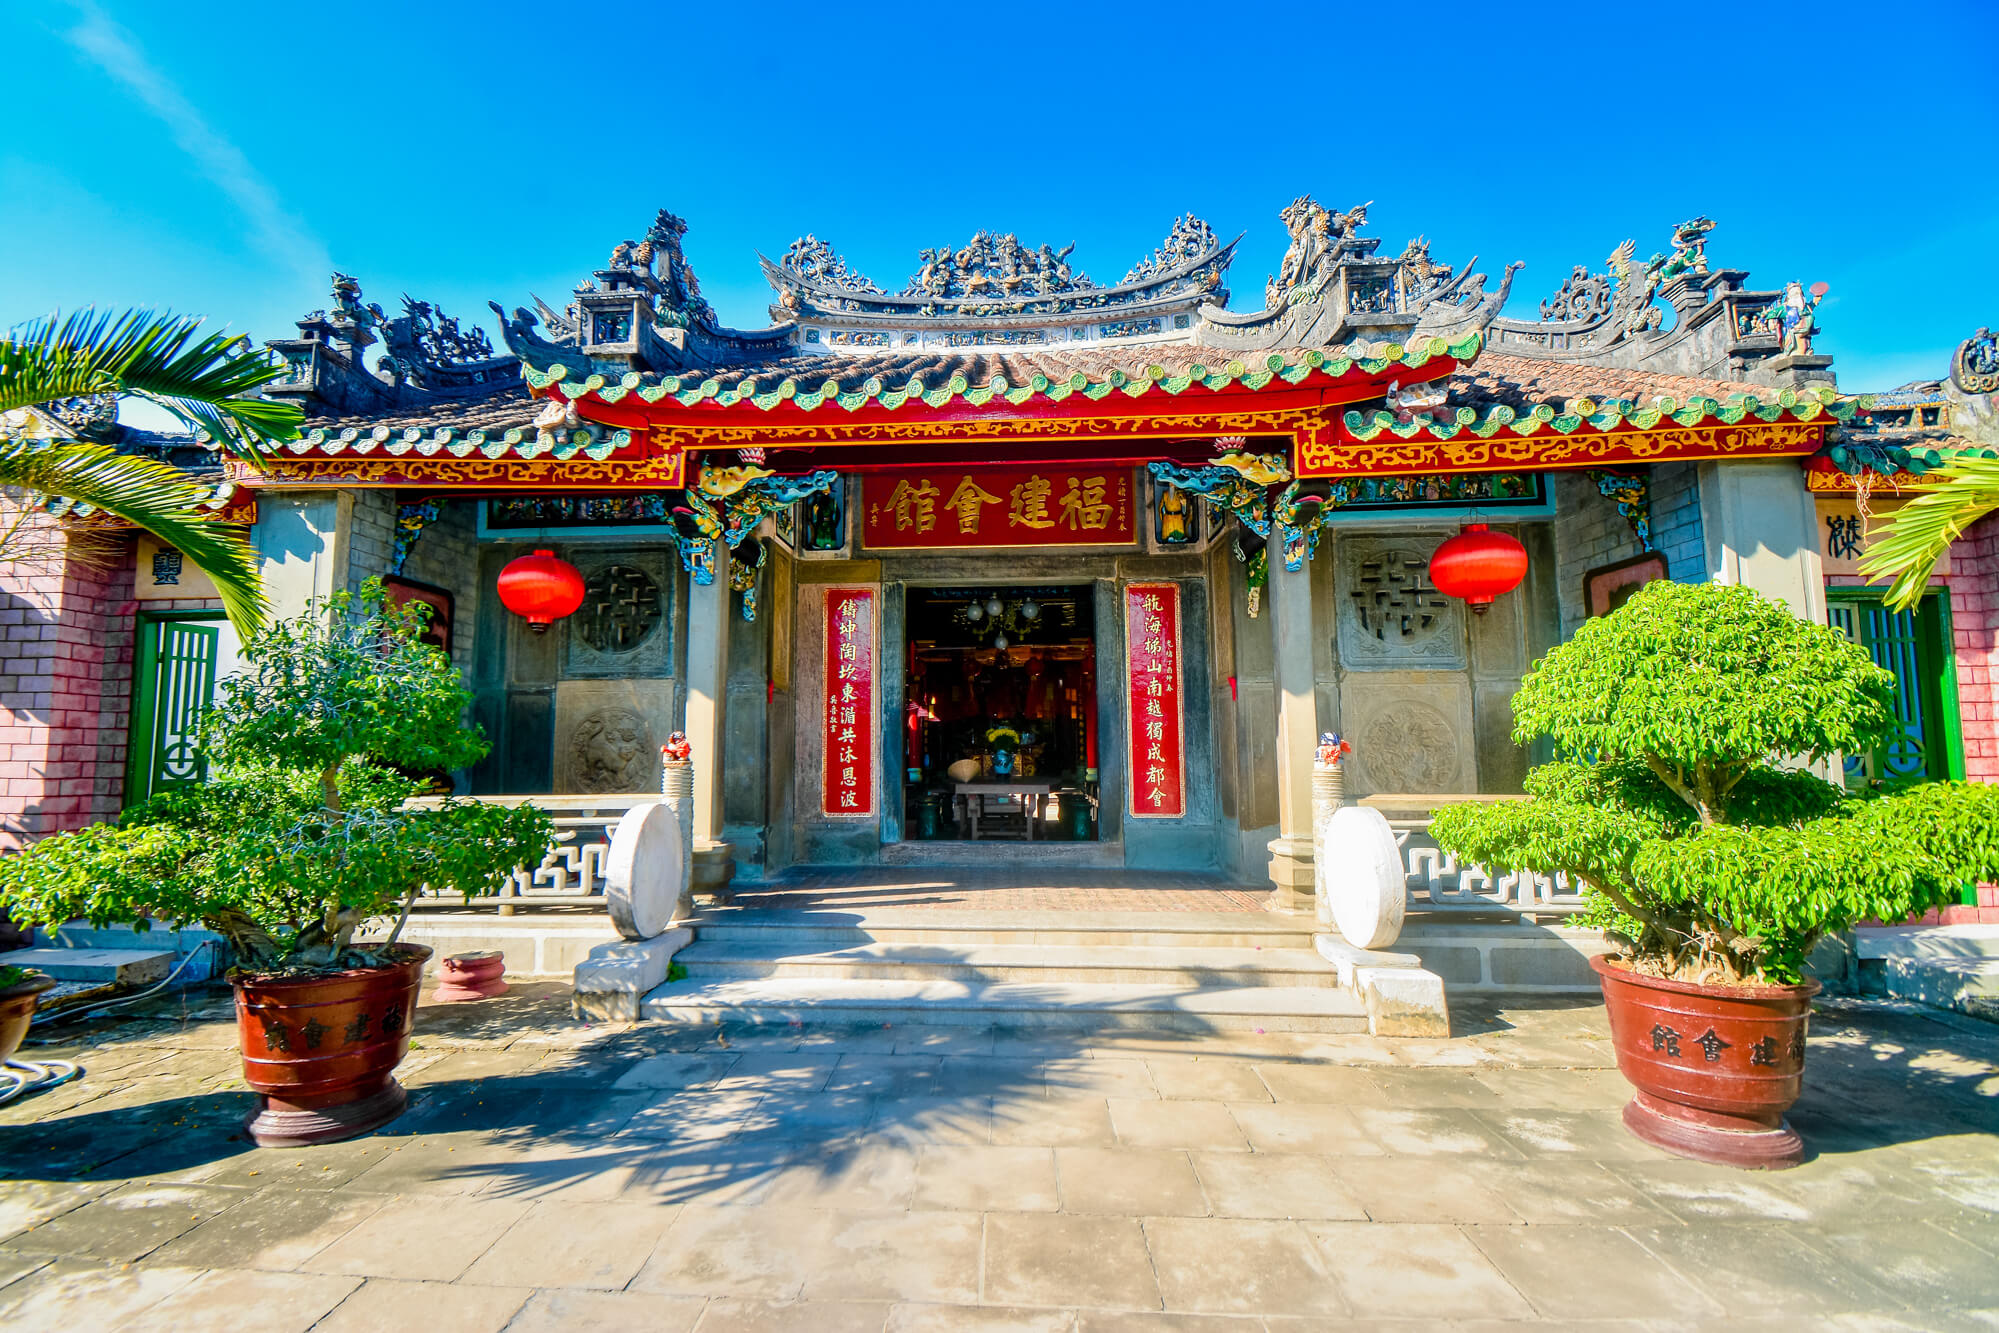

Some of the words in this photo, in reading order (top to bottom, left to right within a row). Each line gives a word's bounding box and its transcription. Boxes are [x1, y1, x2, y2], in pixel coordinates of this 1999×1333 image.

[883, 474, 1114, 535] 福建會館
[1142, 593, 1167, 807] 航海梯山南越獨成都會
